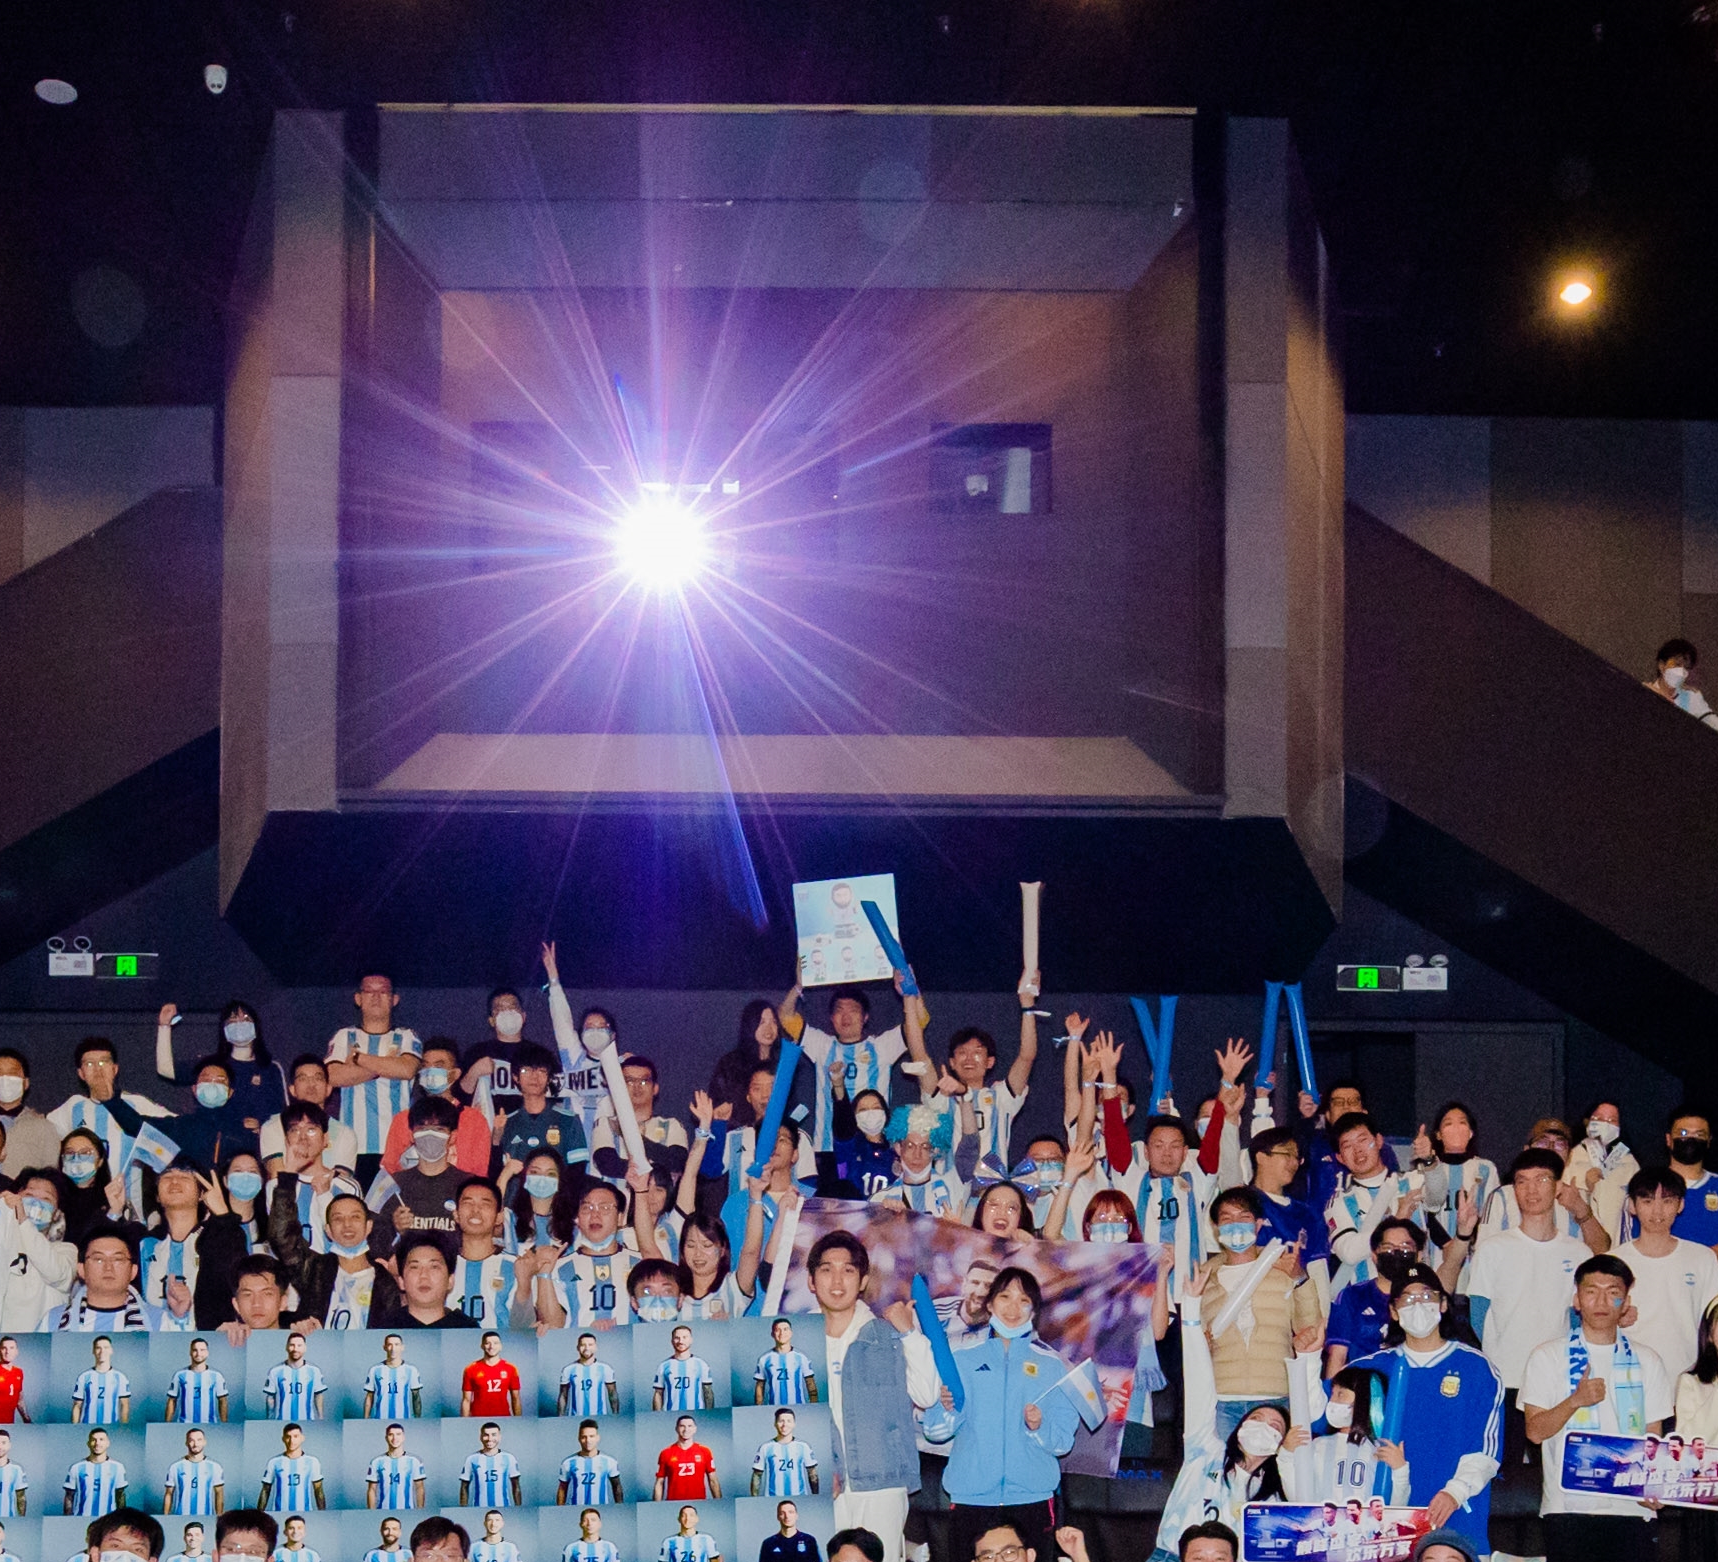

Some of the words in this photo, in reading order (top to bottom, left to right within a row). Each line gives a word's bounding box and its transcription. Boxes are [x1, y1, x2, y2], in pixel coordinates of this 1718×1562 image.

[1157, 1197, 1179, 1221] 10
[588, 1283, 617, 1311] 10
[776, 1369, 790, 1382] 21
[8, 1383, 15, 1396] 1
[288, 1382, 303, 1395] 10
[387, 1381, 399, 1395] 11
[486, 1379, 502, 1393] 12
[579, 1378, 593, 1392] 19
[674, 1376, 690, 1390] 20
[97, 1386, 106, 1399] 2
[193, 1386, 202, 1399] 3
[678, 1462, 695, 1476] 23
[779, 1457, 793, 1471] 24
[484, 1470, 498, 1483] 15
[1336, 1457, 1367, 1487] 10
[93, 1478, 101, 1491] 5
[189, 1477, 198, 1490] 6
[287, 1474, 300, 1487] 13
[389, 1473, 402, 1486] 14
[581, 1473, 595, 1486] 22
